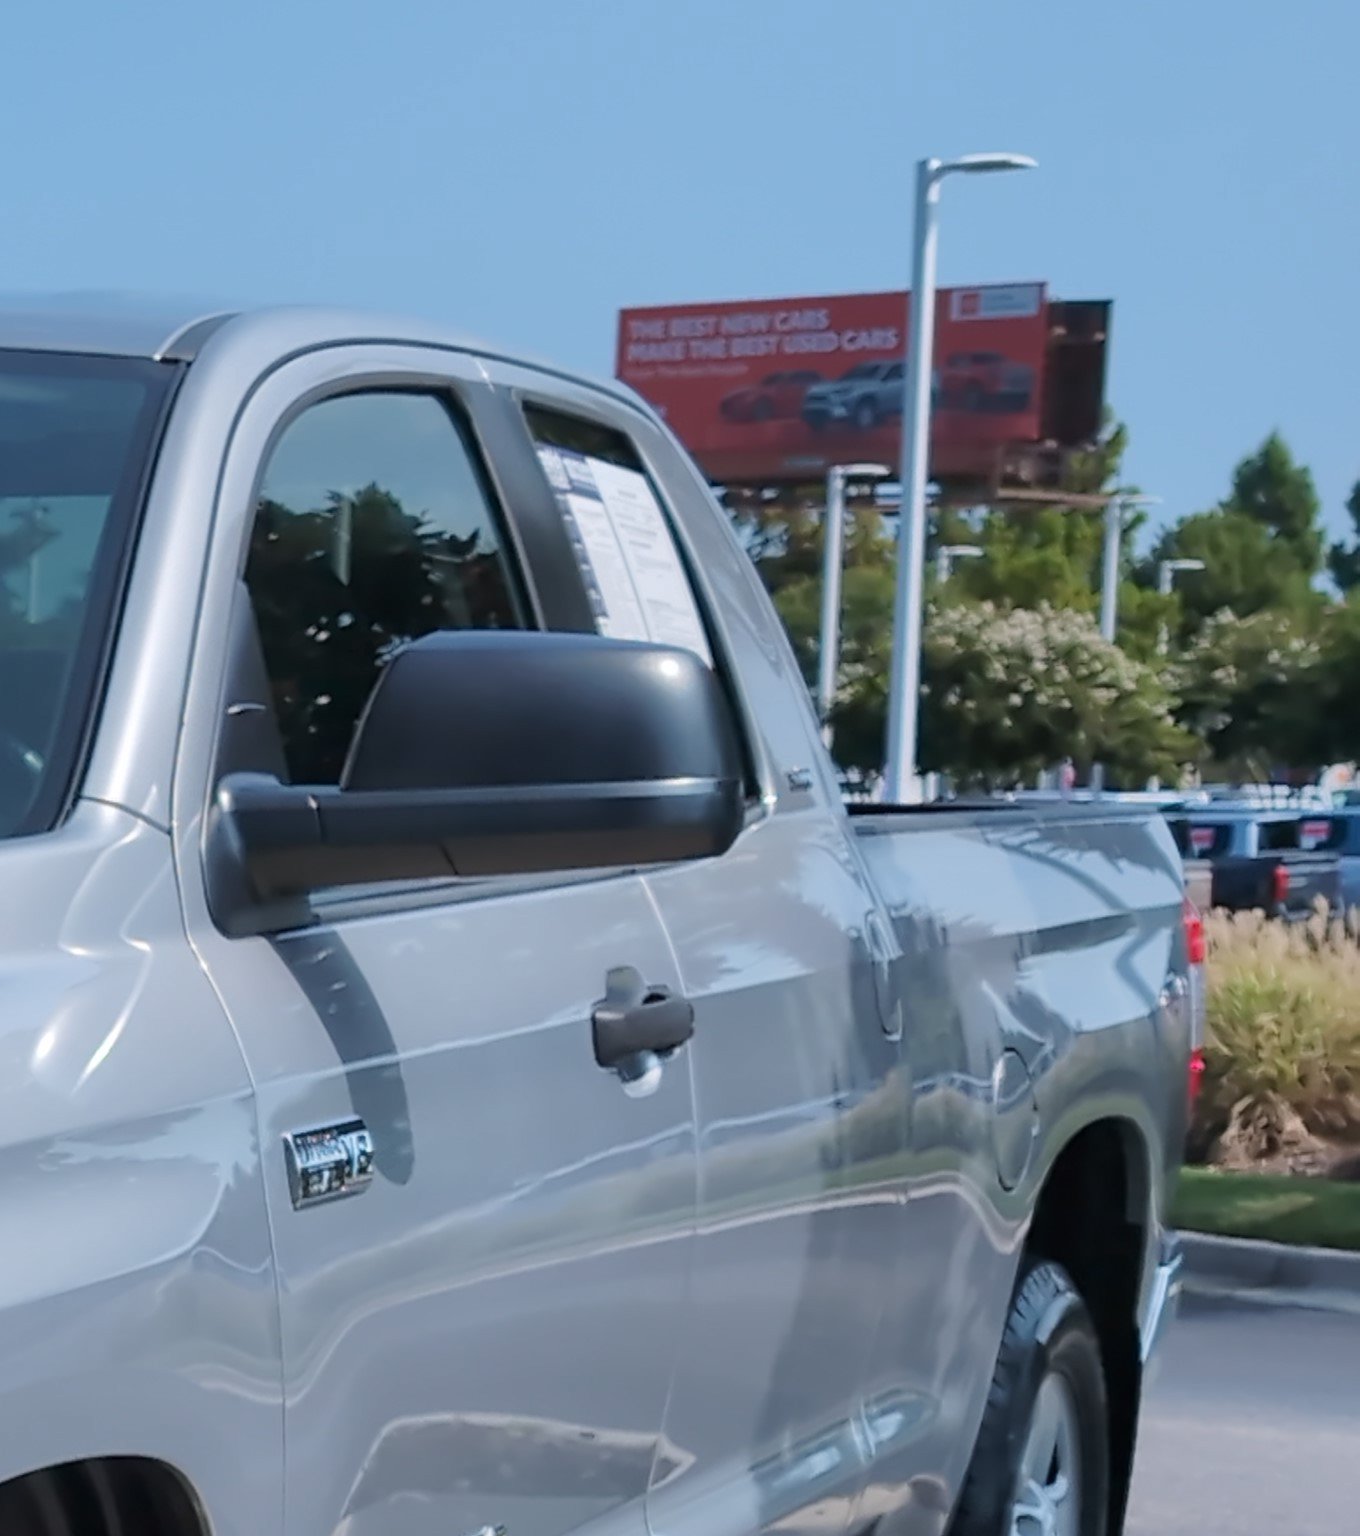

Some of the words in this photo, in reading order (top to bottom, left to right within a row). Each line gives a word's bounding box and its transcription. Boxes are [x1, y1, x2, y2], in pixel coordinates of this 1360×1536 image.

[627, 320, 666, 340] THE
[669, 315, 716, 337] BEST
[720, 312, 771, 334] NEW
[775, 307, 830, 331] CARS
[627, 341, 685, 362] MAKE
[688, 339, 726, 360] THE
[730, 335, 777, 357] BEST
[783, 331, 839, 354] USED
[841, 328, 898, 351] CARS
